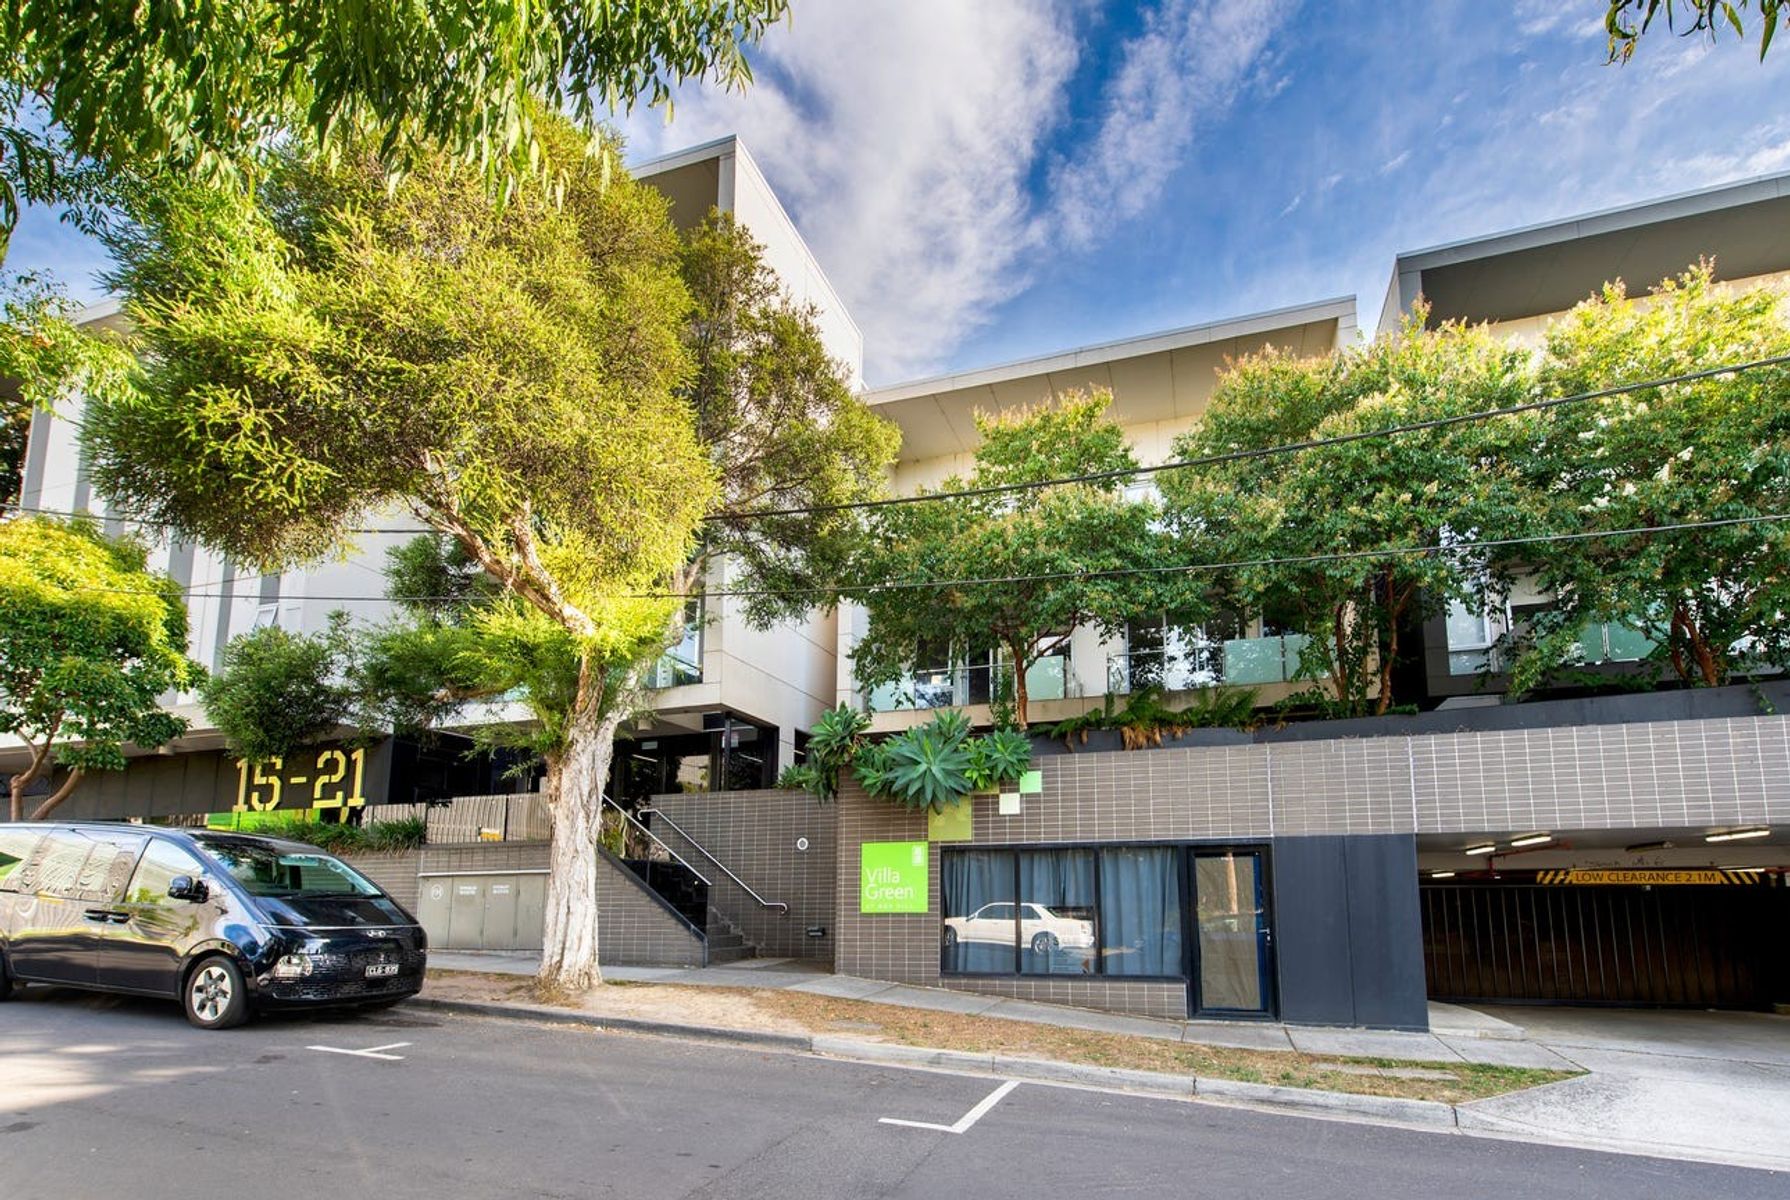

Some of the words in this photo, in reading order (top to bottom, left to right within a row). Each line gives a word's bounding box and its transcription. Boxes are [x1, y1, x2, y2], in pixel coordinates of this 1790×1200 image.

[232, 748, 366, 811] 15-21
[865, 867, 901, 883] Villa
[1576, 872, 1603, 882] LOW
[1608, 872, 1681, 882] CLEARANCE
[1686, 872, 1717, 882] 2.1M
[865, 883, 914, 900] Green
